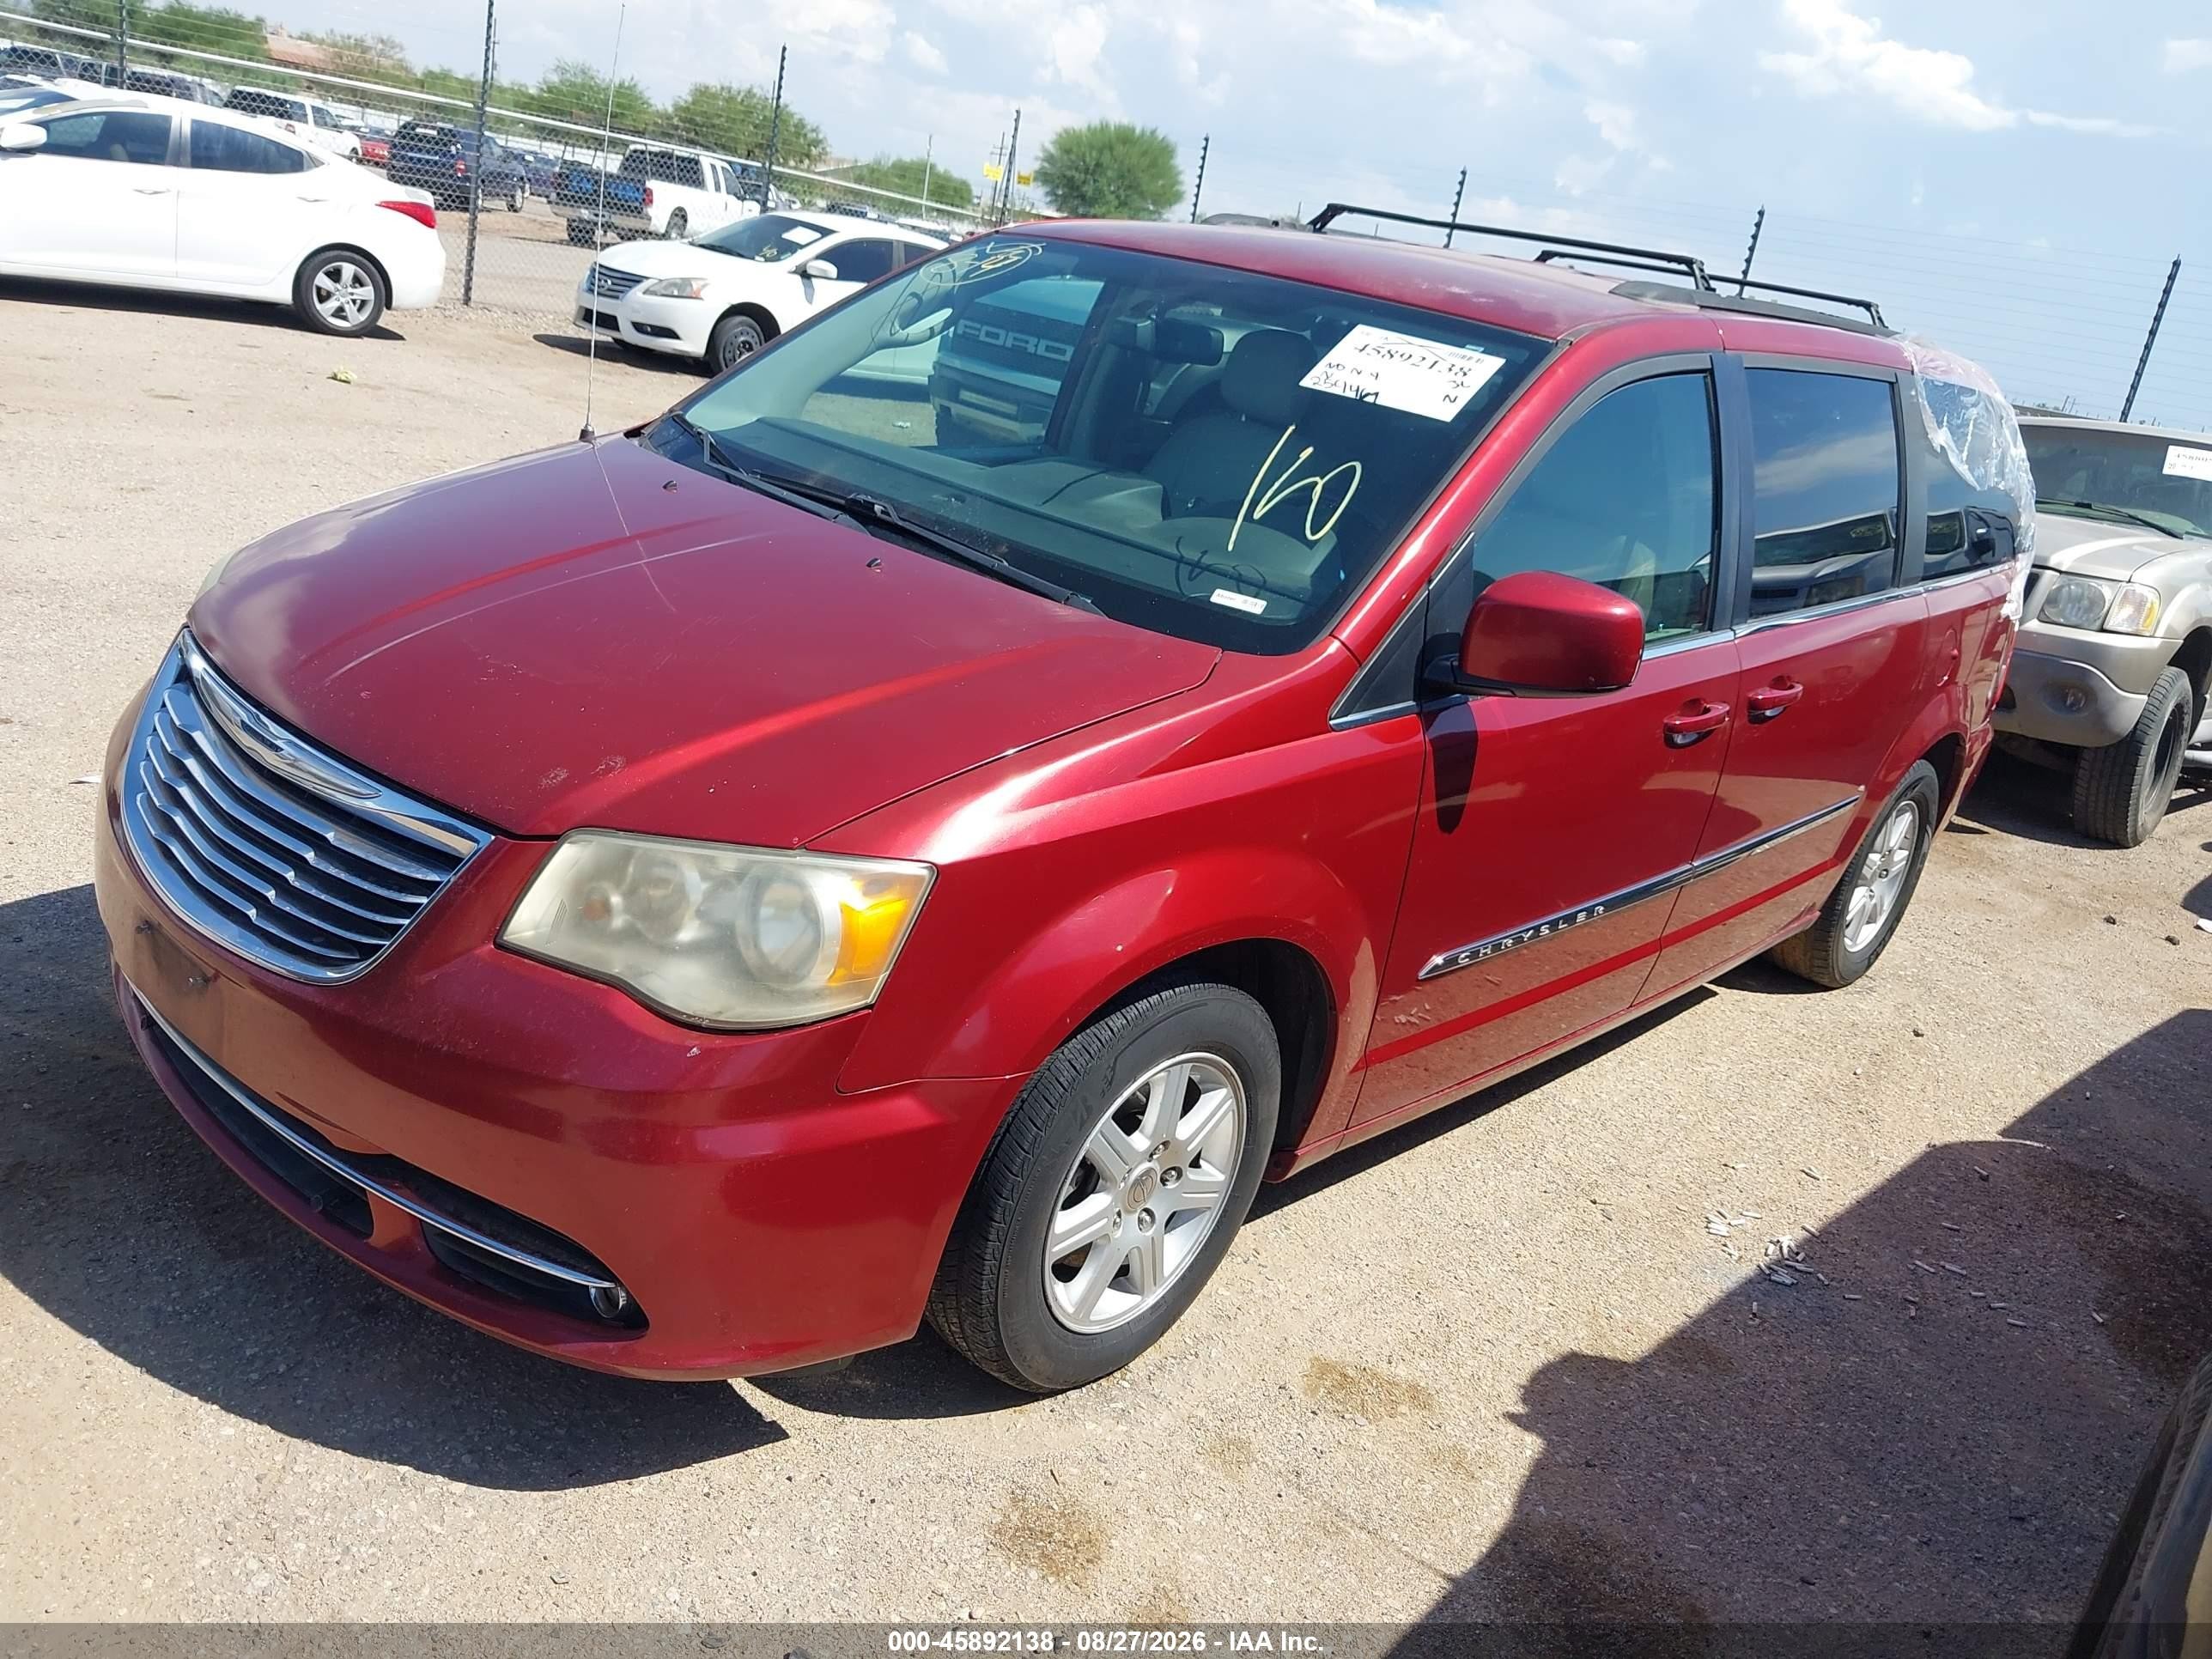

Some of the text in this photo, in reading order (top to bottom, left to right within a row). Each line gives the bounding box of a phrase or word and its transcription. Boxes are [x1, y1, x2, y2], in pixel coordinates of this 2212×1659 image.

[956, 319, 1074, 363] FORD
[1353, 343, 1473, 377] 45892138
[1457, 904, 1606, 965] CHRYSLER
